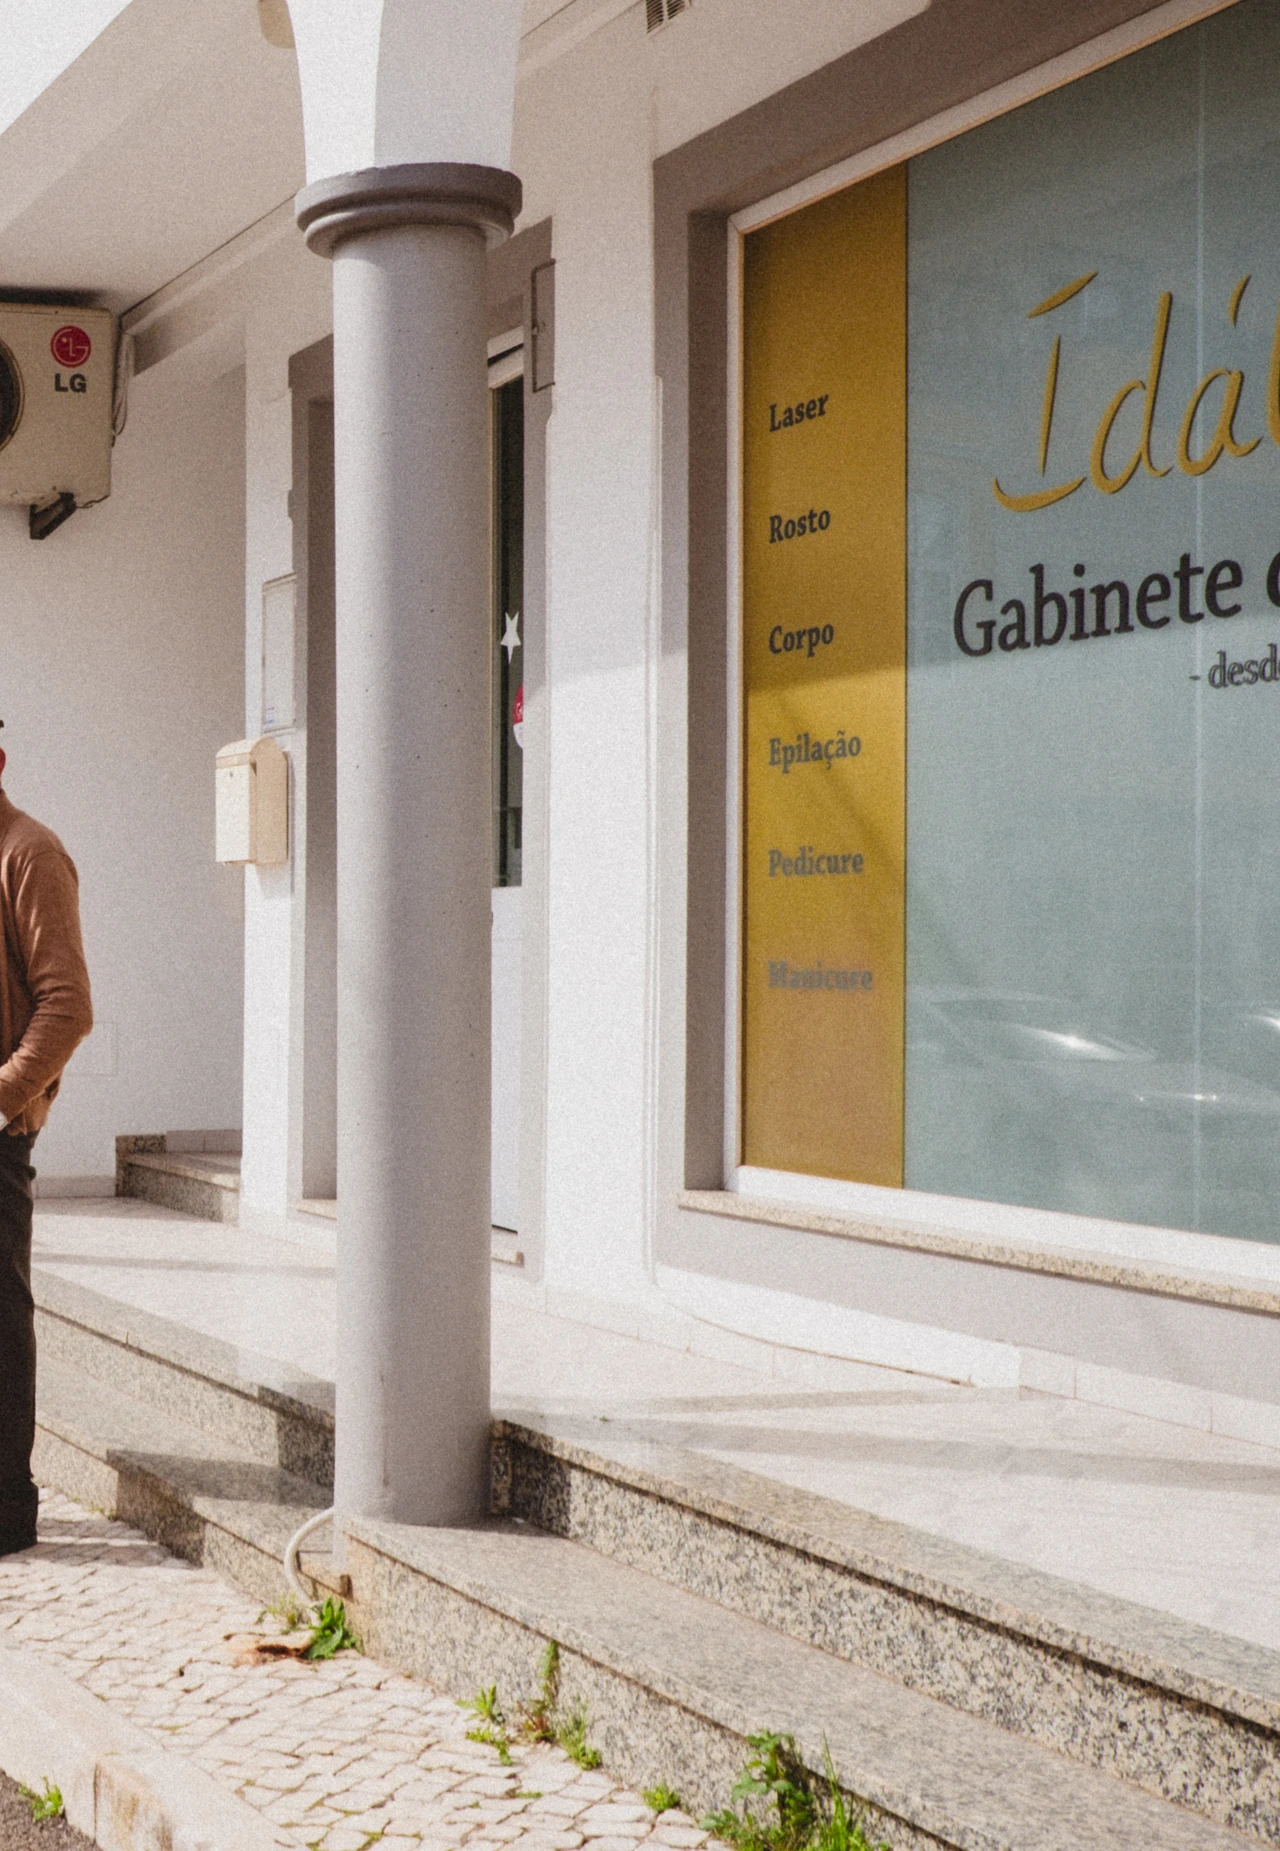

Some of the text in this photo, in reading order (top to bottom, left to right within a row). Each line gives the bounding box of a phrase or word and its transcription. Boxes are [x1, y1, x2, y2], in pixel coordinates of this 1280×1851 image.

[54, 372, 87, 393] LG
[769, 394, 829, 432] Laser
[769, 509, 831, 544] Rosto
[953, 552, 1243, 657] Gabinete
[769, 623, 834, 658] Corpo
[1208, 643, 1280, 689] desd
[769, 729, 861, 774] Epilação
[768, 845, 864, 877] Pedicure
[768, 960, 873, 990] Manicure
